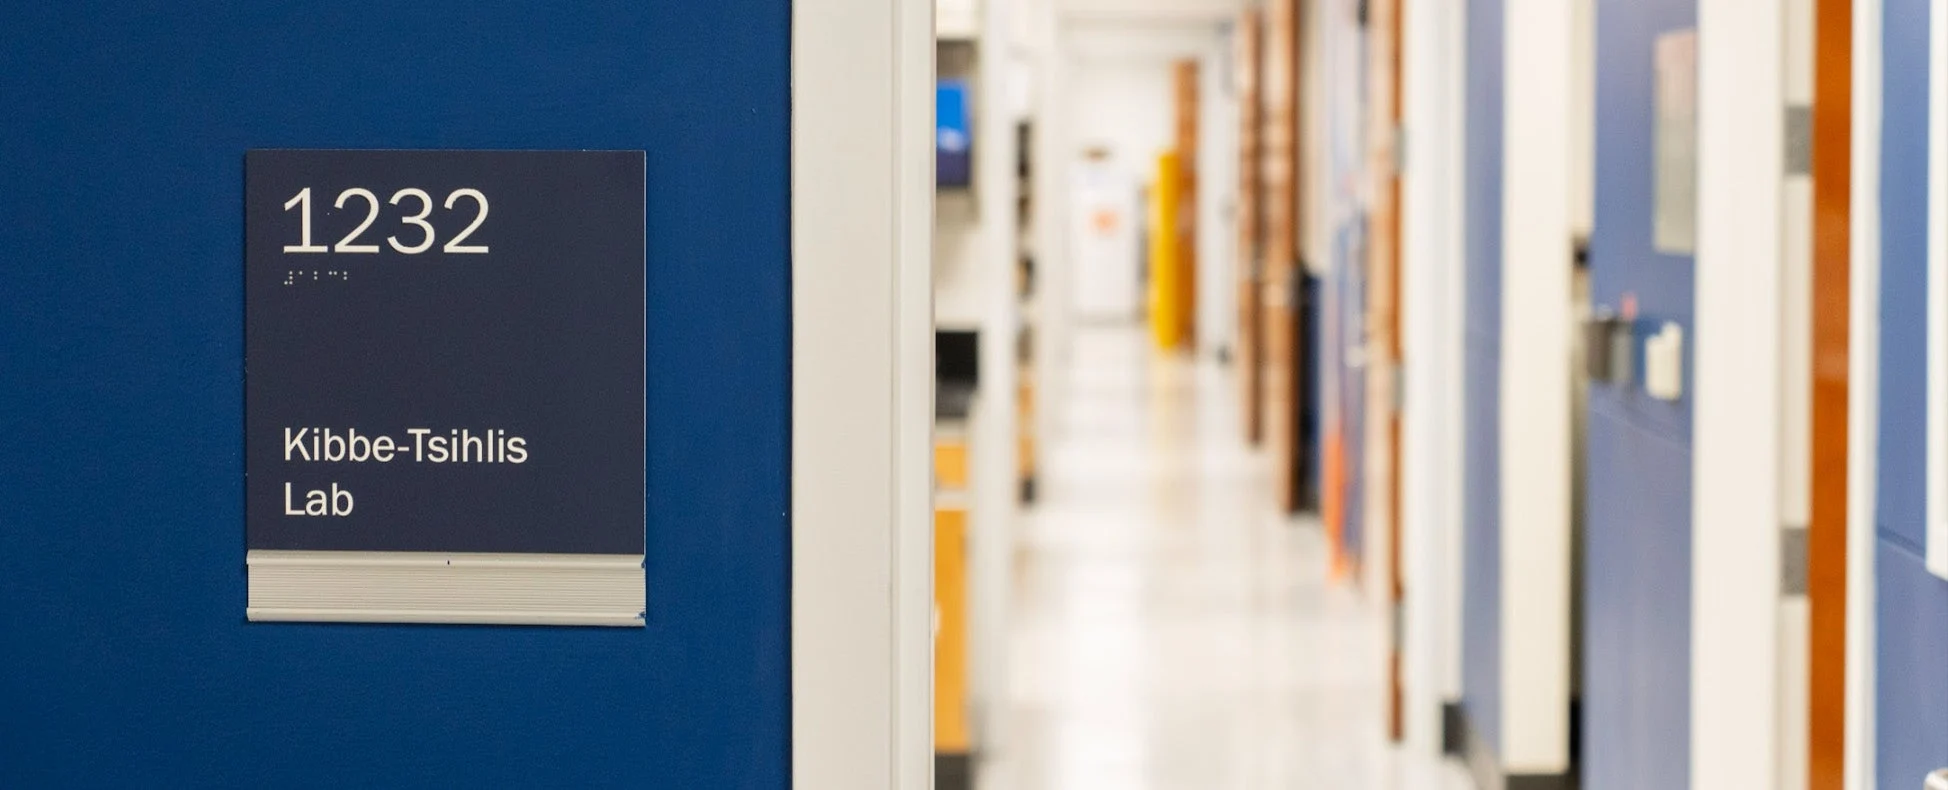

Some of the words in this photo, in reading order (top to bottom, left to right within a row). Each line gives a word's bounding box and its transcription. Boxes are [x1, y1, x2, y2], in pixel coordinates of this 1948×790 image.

[283, 187, 489, 255] 1232
[284, 427, 528, 465] Kibbe-Tsihlis
[284, 481, 354, 517] Lab
